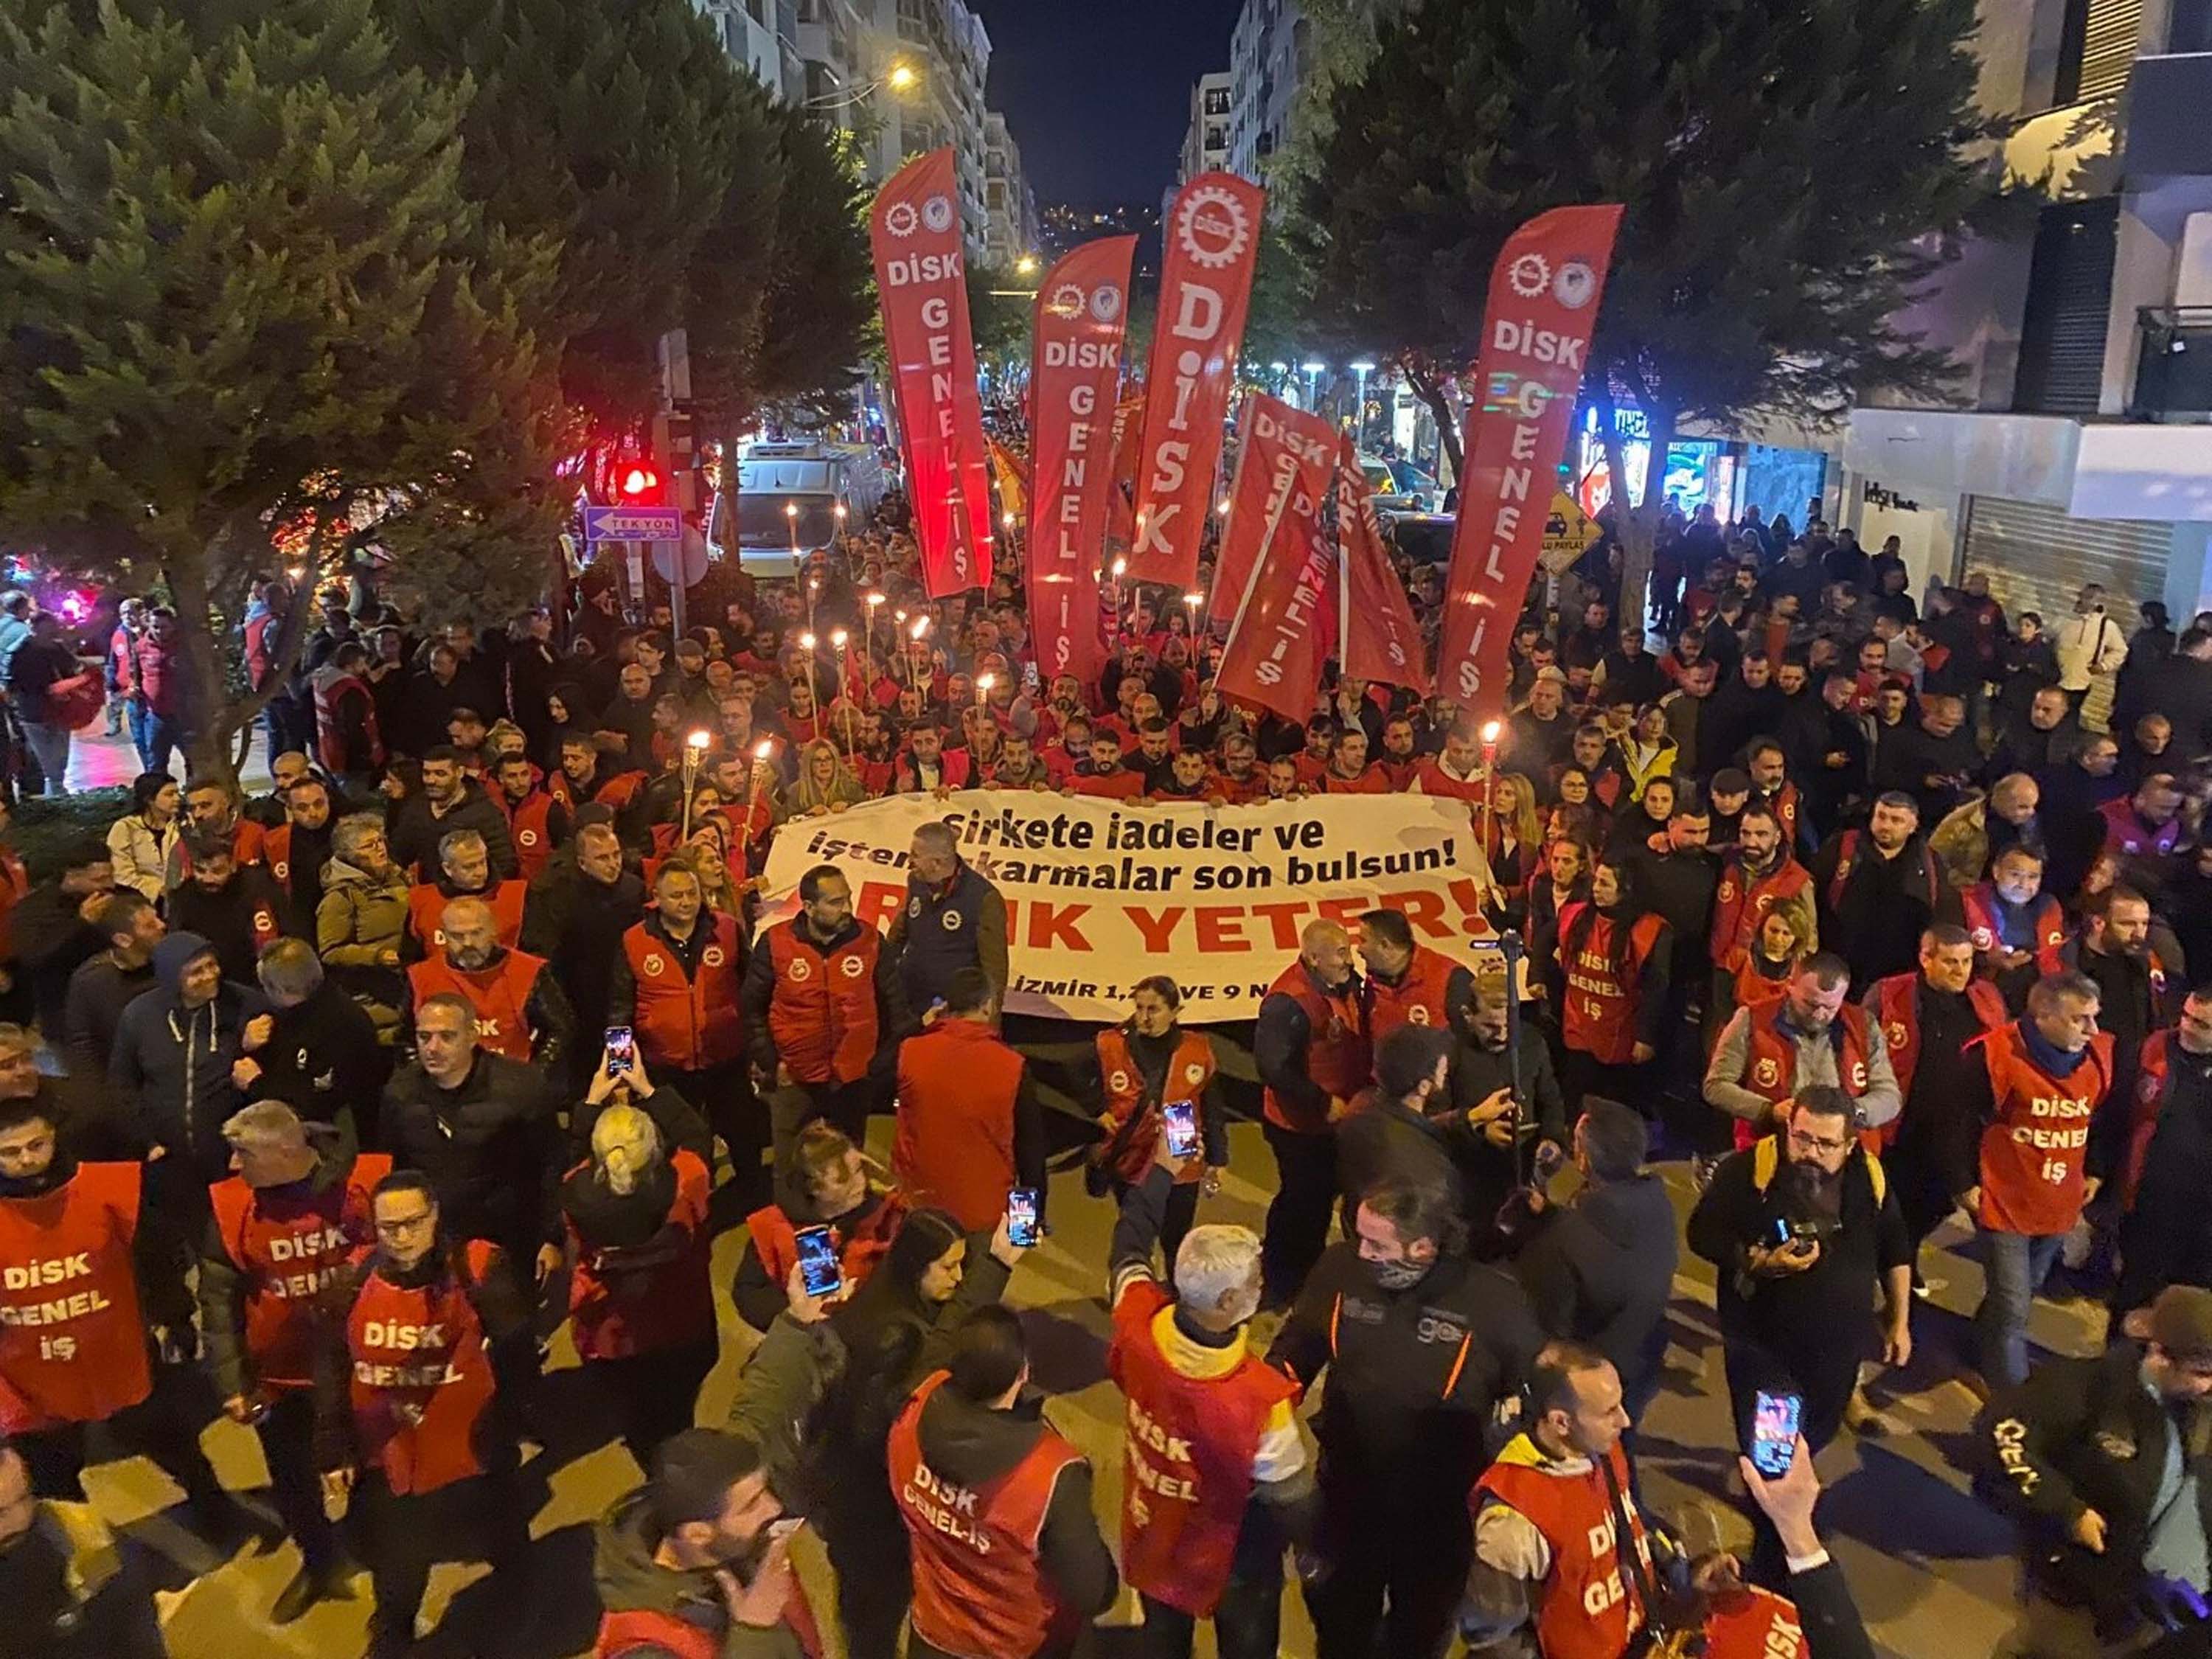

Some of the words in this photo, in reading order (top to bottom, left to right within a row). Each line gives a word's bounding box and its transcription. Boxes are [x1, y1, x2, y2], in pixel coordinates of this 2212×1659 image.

[887, 251, 961, 286] DİSK
[1045, 337, 1119, 369] DİSK
[1493, 319, 1585, 369] DİSK
[1134, 282, 1223, 555] DİSK
[1255, 411, 1329, 467] DİSK
[611, 519, 639, 529] TEK
[1107, 813, 1261, 851] iadeler
[1275, 819, 1324, 850] ve
[964, 851, 1181, 891] karmalar
[1192, 864, 1272, 891] son
[1287, 838, 1457, 886] bulsun!
[1013, 975, 1099, 998] İZMİR
[1180, 985, 1214, 1000] VE
[1222, 984, 1241, 1000] 9
[2031, 1094, 2091, 1119] DİSK
[2042, 1157, 2067, 1186] İŞ
[269, 1222, 350, 1262] DİSK
[4, 1252, 91, 1290] DİSK
[0, 1290, 111, 1326] GENEL
[40, 1335, 77, 1361] İŞ
[364, 1318, 445, 1350] DİSK
